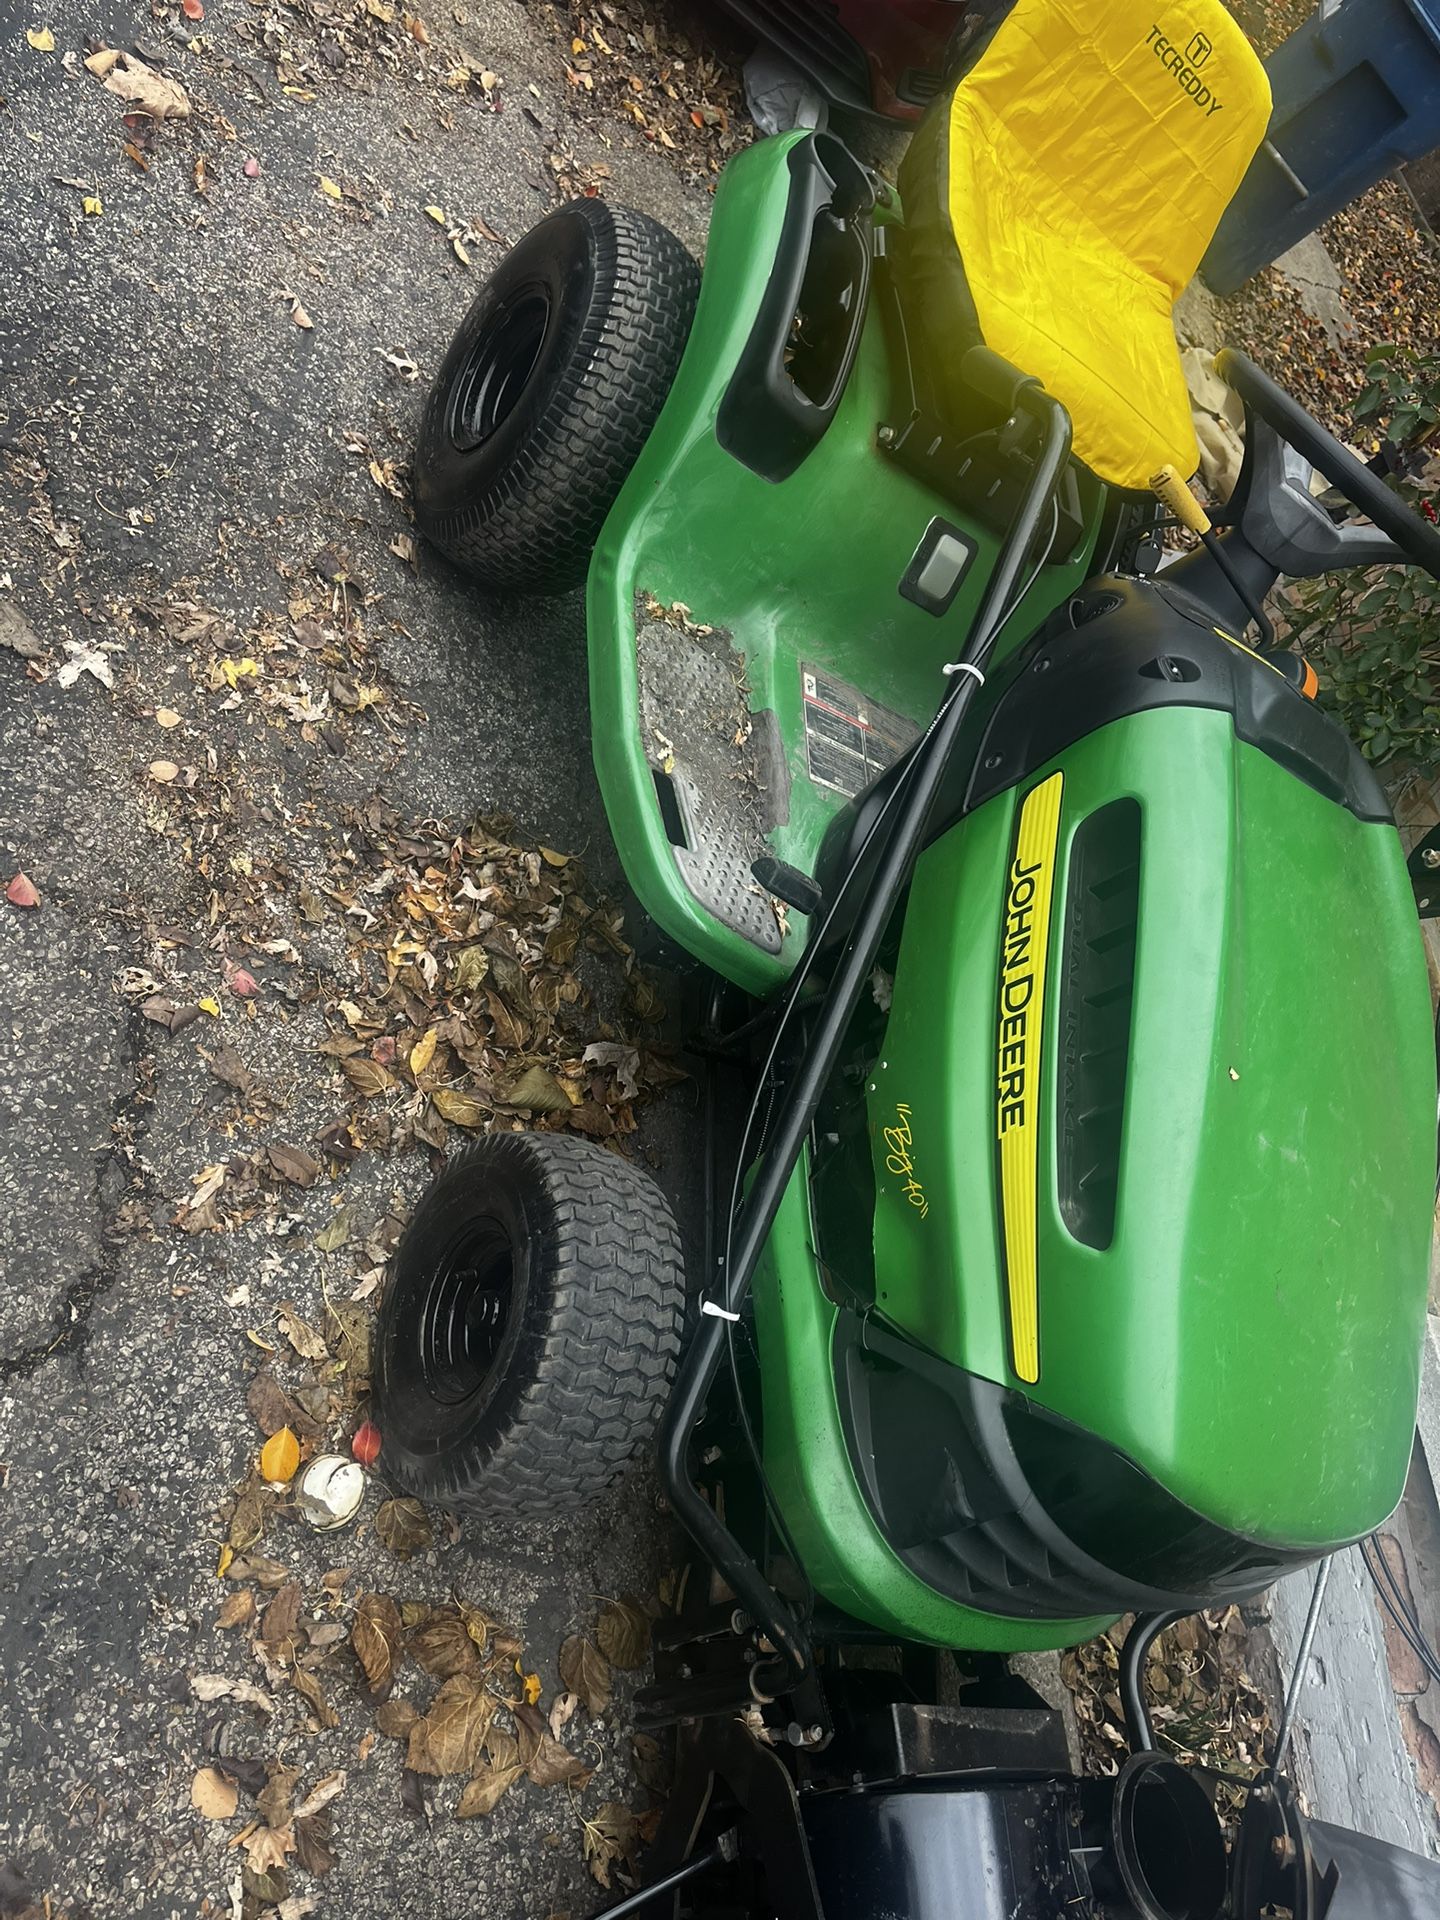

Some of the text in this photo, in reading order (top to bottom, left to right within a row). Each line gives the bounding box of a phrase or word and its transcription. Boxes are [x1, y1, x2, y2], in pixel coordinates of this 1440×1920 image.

[1145, 24, 1223, 117] TECREDDY
[1001, 858, 1042, 1133] JOHN DEERE
